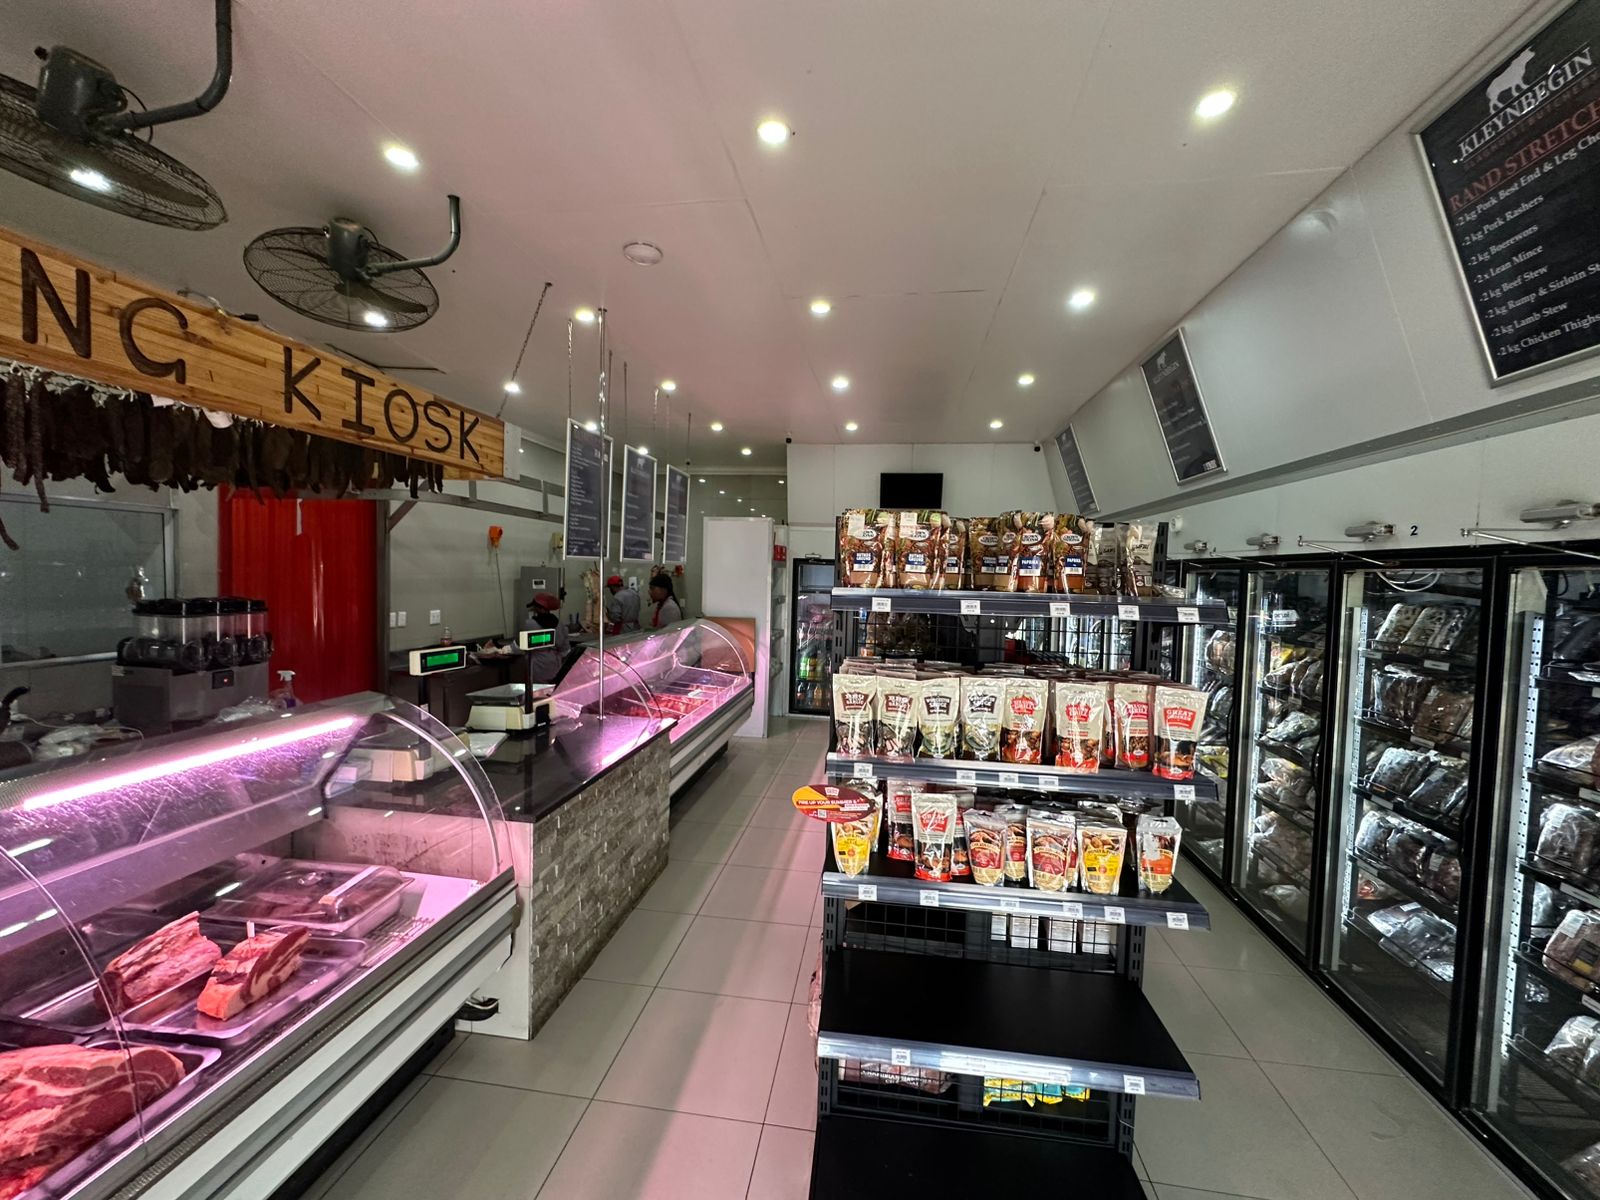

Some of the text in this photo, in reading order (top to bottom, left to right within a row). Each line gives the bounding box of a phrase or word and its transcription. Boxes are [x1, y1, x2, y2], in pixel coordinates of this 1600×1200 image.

[1458, 47, 1593, 158] KLEYNBEGIN
[1449, 168, 1501, 211] RAND
[1476, 196, 1498, 213] Pork
[1498, 182, 1520, 200] Best
[1520, 168, 1541, 186] End
[1543, 161, 1554, 173] &
[1554, 148, 1578, 165] Leg
[1483, 217, 1505, 234] Pork
[1505, 195, 1544, 221] Rashers
[1489, 225, 1538, 254] Boerewors
[1490, 262, 1512, 277] Lean
[1512, 246, 1543, 265] Mince
[1501, 275, 1522, 292] Beef
[1523, 265, 1549, 281] Stew
[1507, 293, 1537, 310] Rump
[1538, 287, 1548, 297] &
[1548, 270, 1587, 291] Sirloin
[1513, 312, 1541, 329] Lamb
[1541, 302, 1568, 318] Stew
[1520, 328, 1562, 348] Chicken
[283, 346, 480, 463] KIOSK
[1410, 525, 1418, 536] 2
